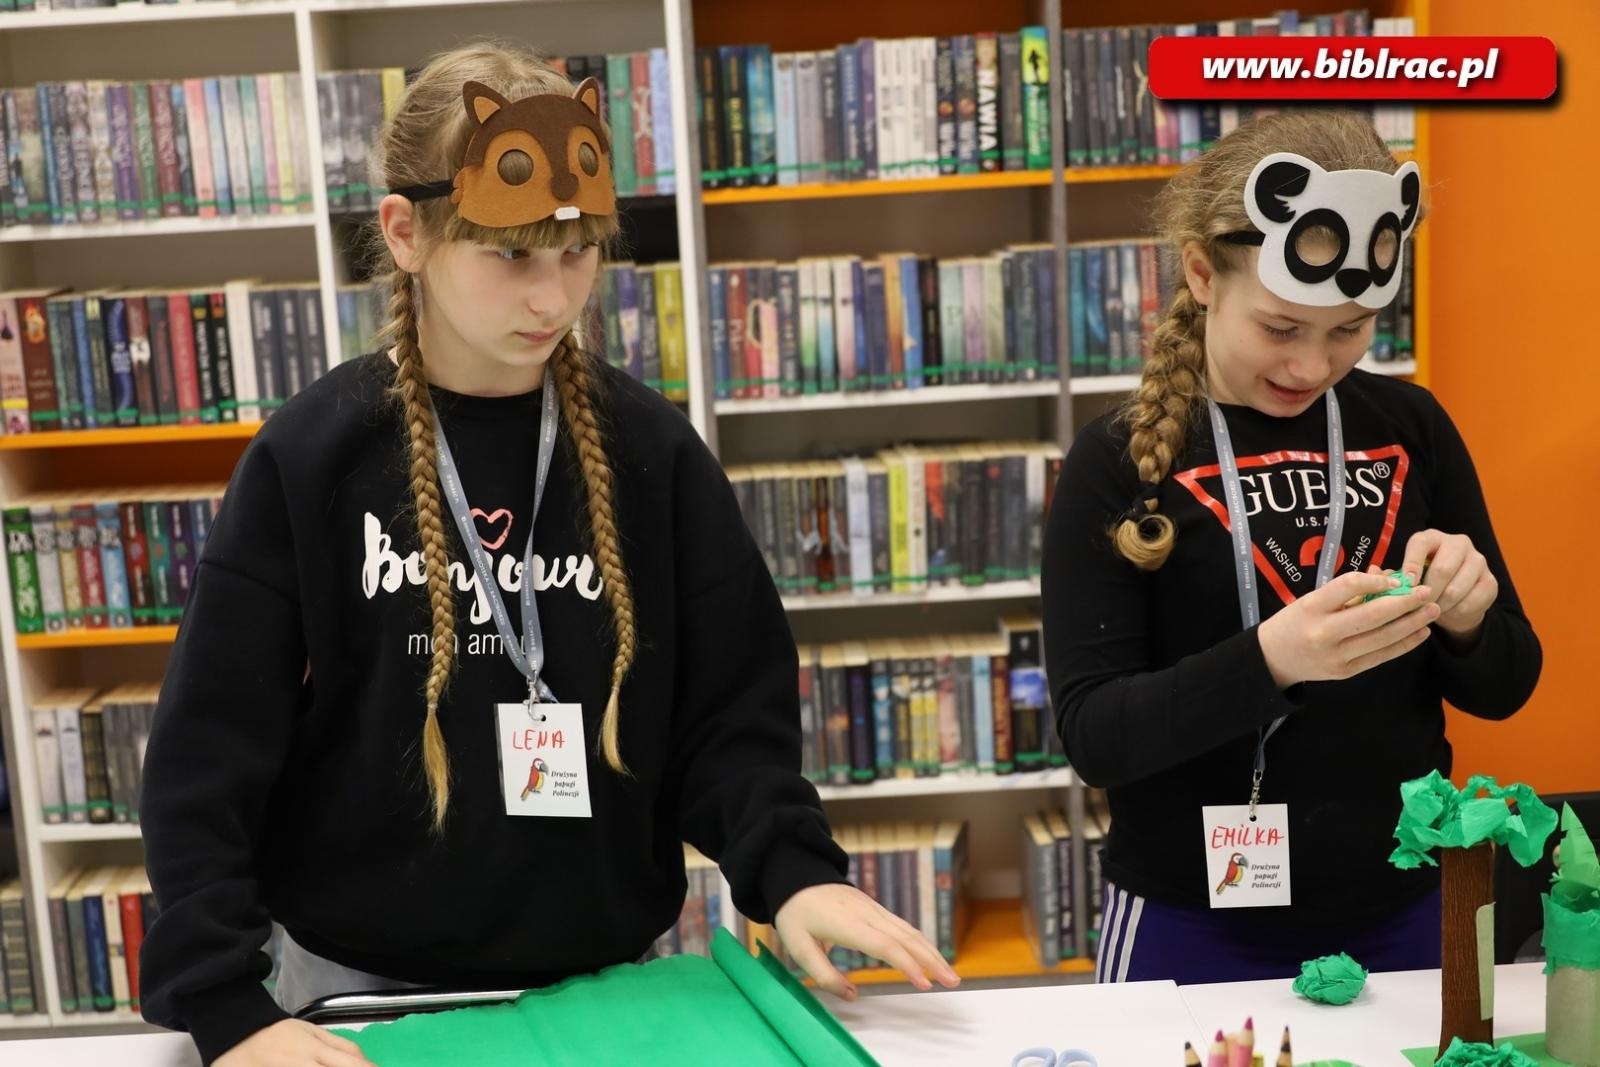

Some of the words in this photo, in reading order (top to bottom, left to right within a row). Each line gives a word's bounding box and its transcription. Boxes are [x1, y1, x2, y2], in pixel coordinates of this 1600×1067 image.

[977, 69, 997, 150] NAWIA
[1265, 537, 1303, 583] WASHED
[512, 728, 566, 750] LENA
[554, 780, 576, 789] papugi
[1254, 872, 1278, 881] papugi
[1251, 881, 1281, 889] Polinezji
